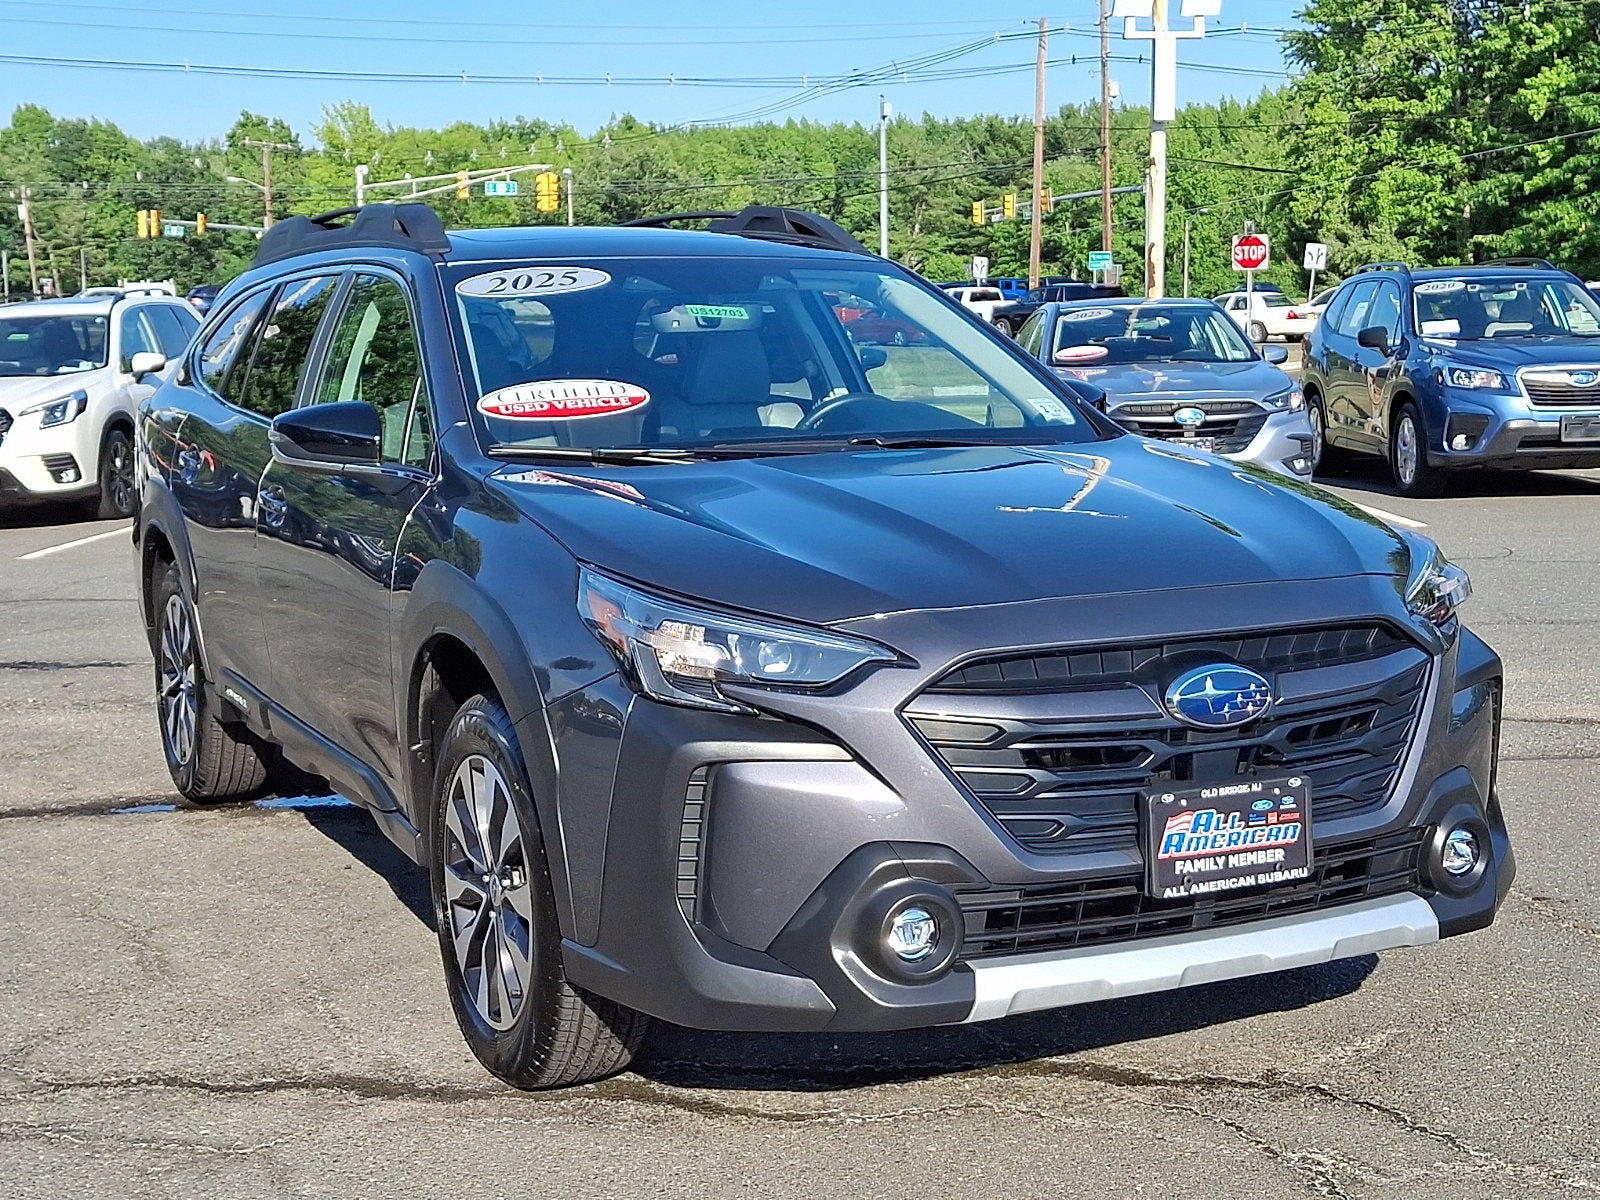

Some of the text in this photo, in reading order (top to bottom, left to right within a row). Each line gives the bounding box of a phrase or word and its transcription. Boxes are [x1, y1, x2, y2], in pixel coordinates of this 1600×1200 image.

[1234, 245, 1266, 261] STOP
[486, 271, 579, 293] 2025
[1424, 283, 1455, 291] 2020
[690, 307, 744, 317] US12703
[497, 384, 627, 403] CERTIFIED
[498, 396, 632, 415] USED VEHICLE
[1201, 788, 1218, 798] OLD
[1251, 782, 1263, 792] NJ
[1190, 810, 1243, 834] ALL
[1161, 824, 1301, 856] AMERICAN
[1174, 848, 1286, 875] FAMILY MEMBER
[1162, 867, 1309, 898] ALL AMERICAN SUBARU
